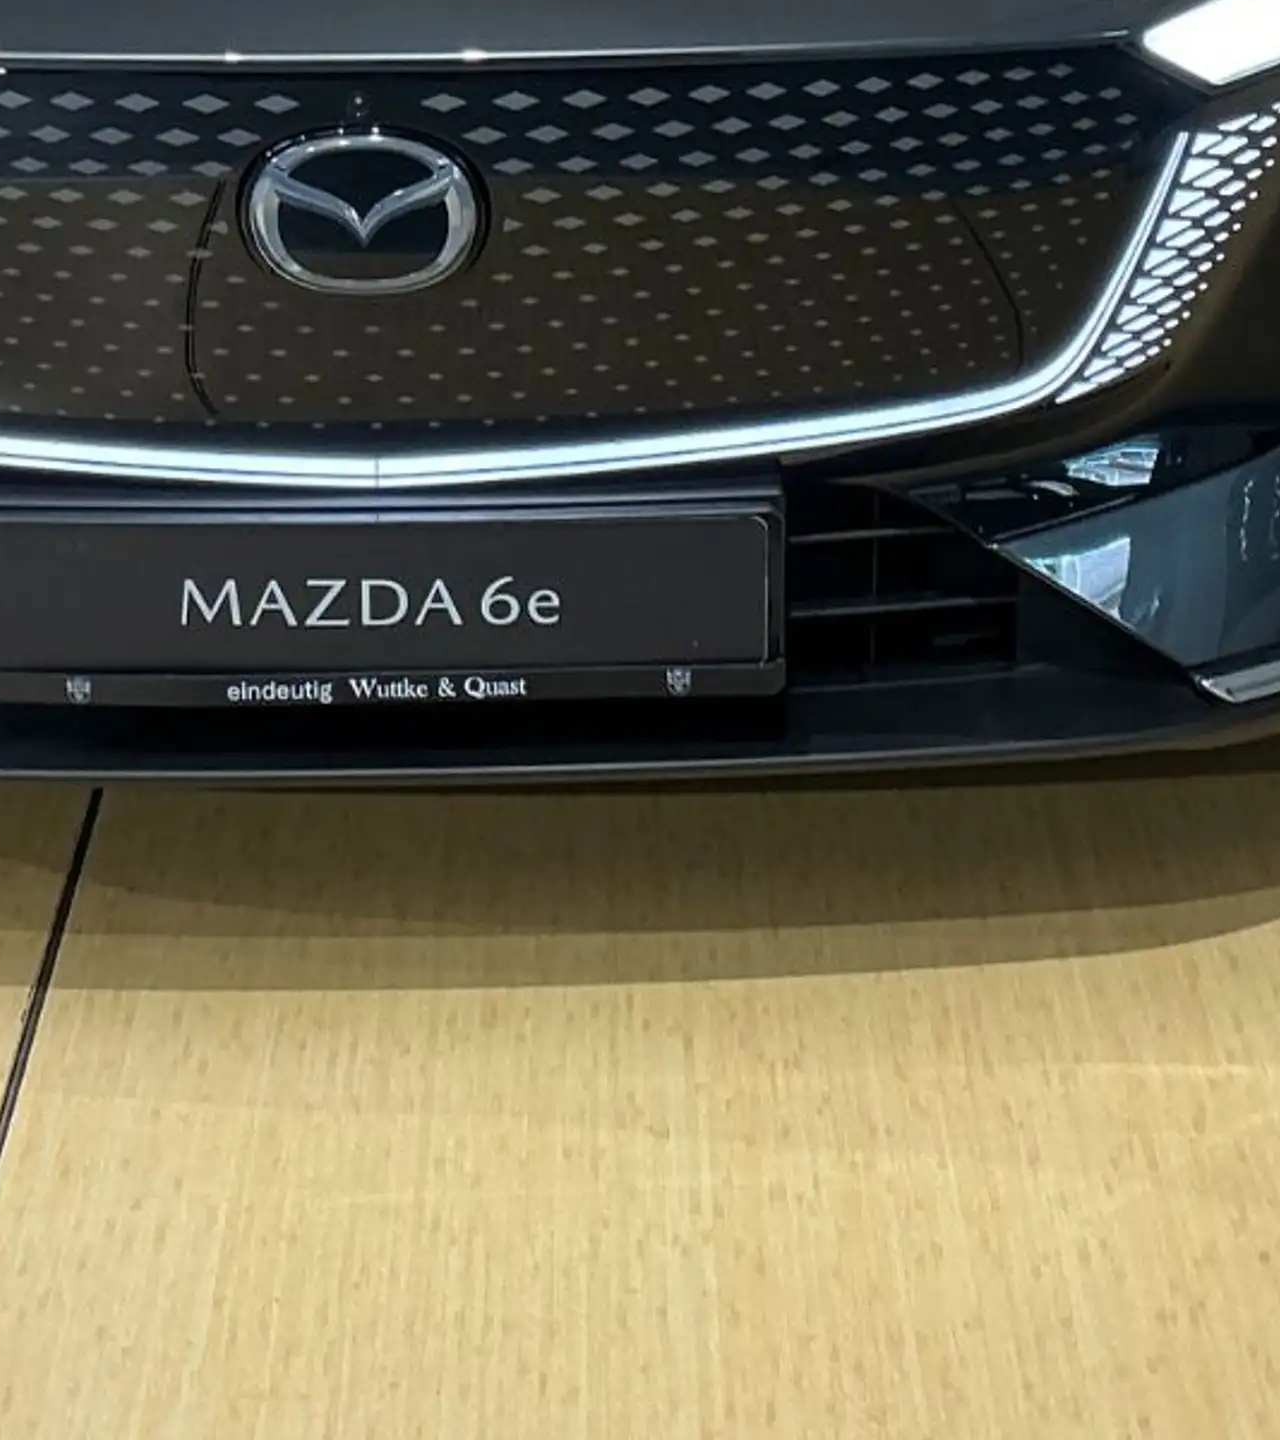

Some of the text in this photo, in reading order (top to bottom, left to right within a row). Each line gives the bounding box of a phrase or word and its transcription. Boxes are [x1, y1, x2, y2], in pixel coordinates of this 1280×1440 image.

[180, 575, 561, 628] MAZDA 6e
[226, 674, 527, 704] eindeutig Wuttke & Quast
